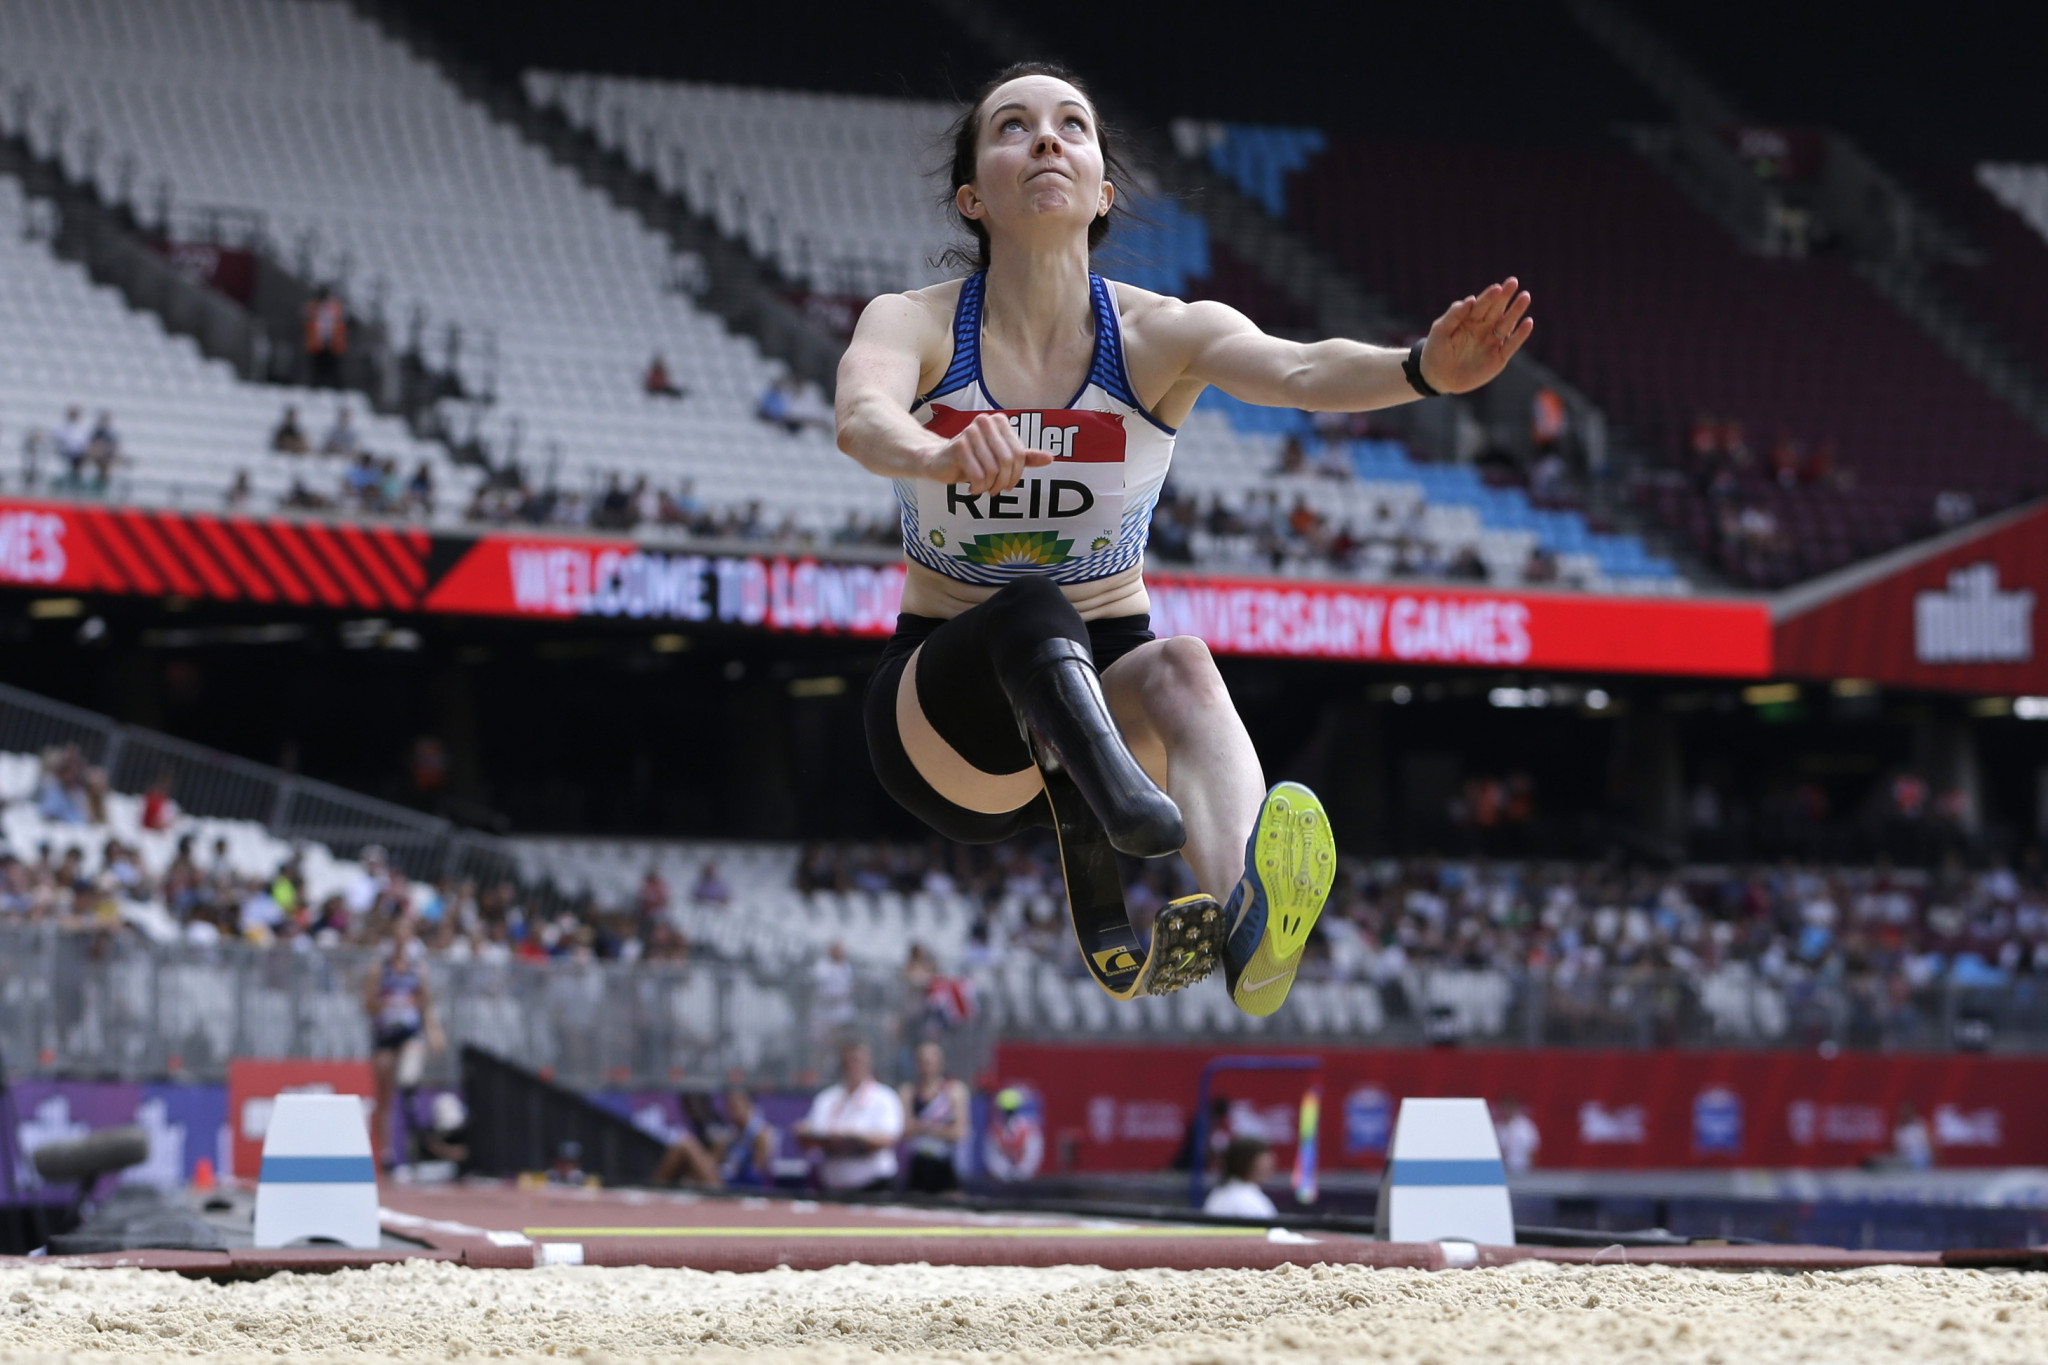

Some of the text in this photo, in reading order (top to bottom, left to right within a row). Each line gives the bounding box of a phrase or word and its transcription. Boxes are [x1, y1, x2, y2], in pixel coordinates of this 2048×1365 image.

[1008, 412, 1080, 458] ller
[947, 478, 1095, 520] REID
[507, 547, 902, 634] WELCOME TO LONDO
[1388, 597, 1532, 664] GAMES
